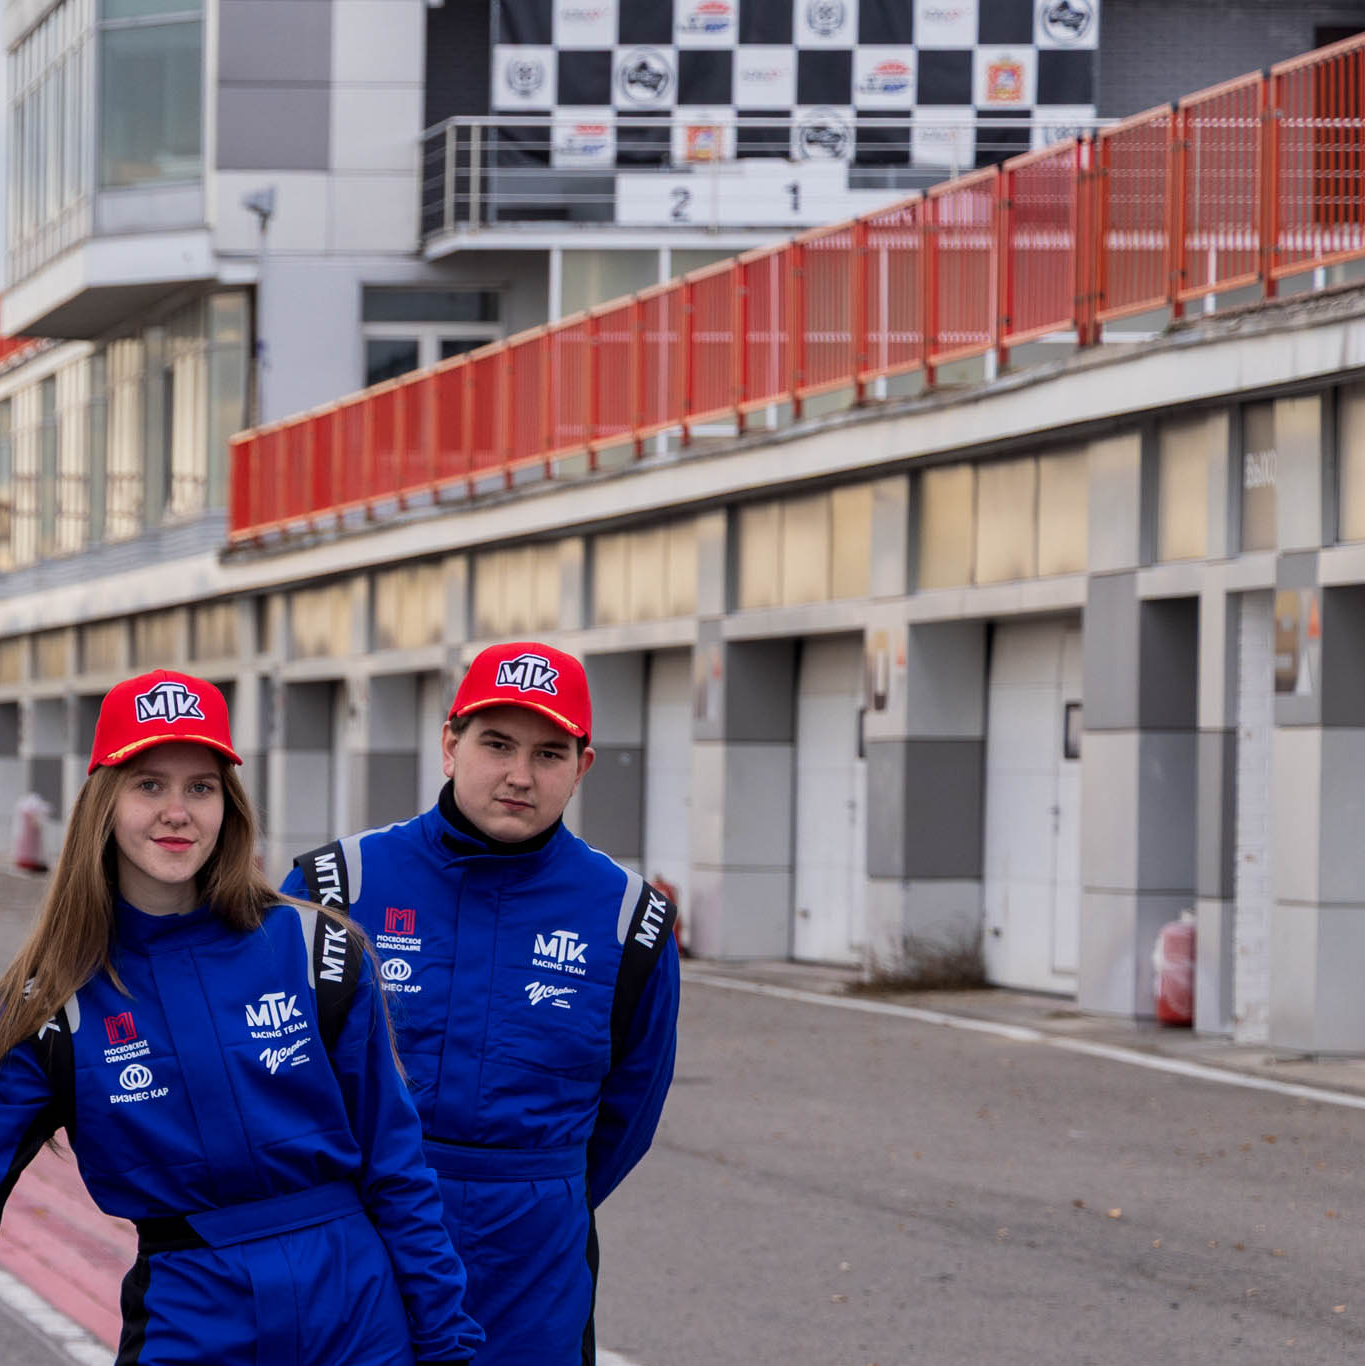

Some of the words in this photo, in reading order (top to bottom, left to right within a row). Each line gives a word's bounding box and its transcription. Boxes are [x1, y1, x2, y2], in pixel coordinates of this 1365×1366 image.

[671, 186, 692, 222] 2
[785, 181, 800, 212] 1
[532, 958, 563, 971] RACING
[564, 965, 587, 976] TEAM
[404, 984, 422, 993] КАР
[250, 1029, 283, 1039] RACING
[283, 1020, 308, 1035] TEAM
[110, 1091, 150, 1104] БИЗНЕС
[150, 1087, 170, 1099] КАР
